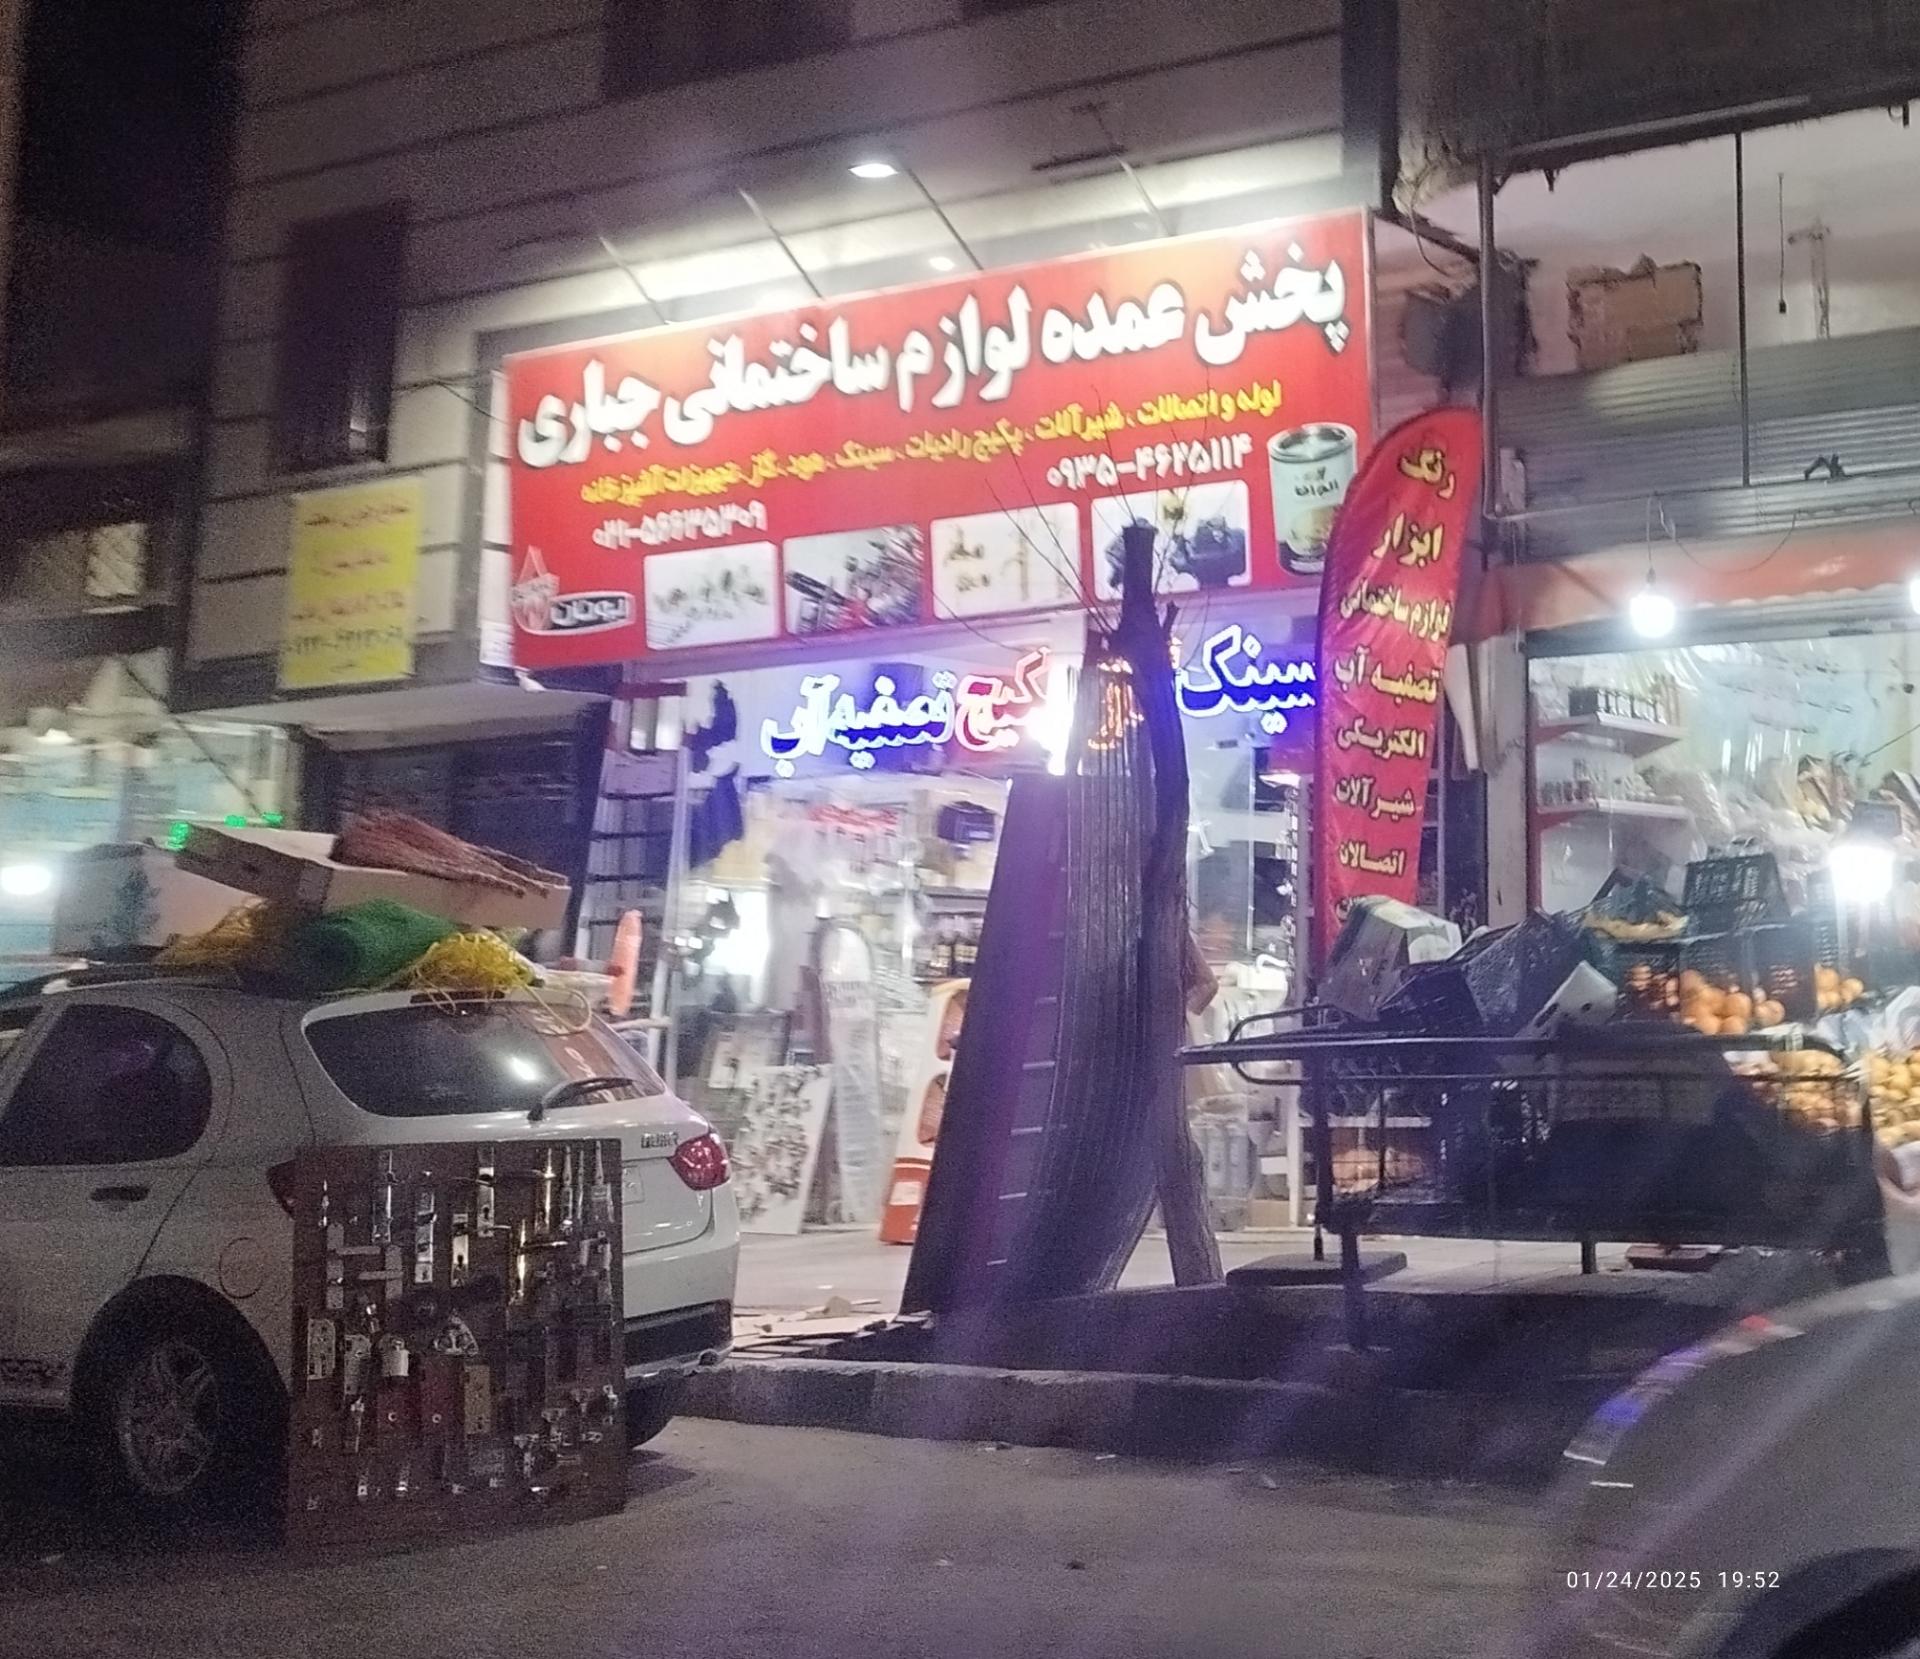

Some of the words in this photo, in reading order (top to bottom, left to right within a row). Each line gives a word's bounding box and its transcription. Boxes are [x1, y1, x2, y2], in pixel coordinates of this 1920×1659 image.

[1041, 281, 1186, 363] عمده
[1195, 242, 1349, 364] پخش
[896, 285, 1031, 412] لوازم
[663, 316, 889, 445] ساختمانی
[1219, 393, 1236, 422] و
[1237, 379, 1282, 417] لوله
[517, 360, 661, 467] جباری
[1373, 513, 1443, 567] ابزار
[1340, 579, 1409, 622] ساختمانی
[1409, 600, 1450, 642] لوازم
[1175, 624, 1316, 735] سینک
[1334, 645, 1370, 691] آب
[1371, 662, 1439, 704] تصفیه
[760, 673, 840, 778] آب
[827, 671, 957, 770] تصفیه
[1337, 716, 1426, 759] الکتریکی
[1339, 841, 1405, 876] اتصالات
